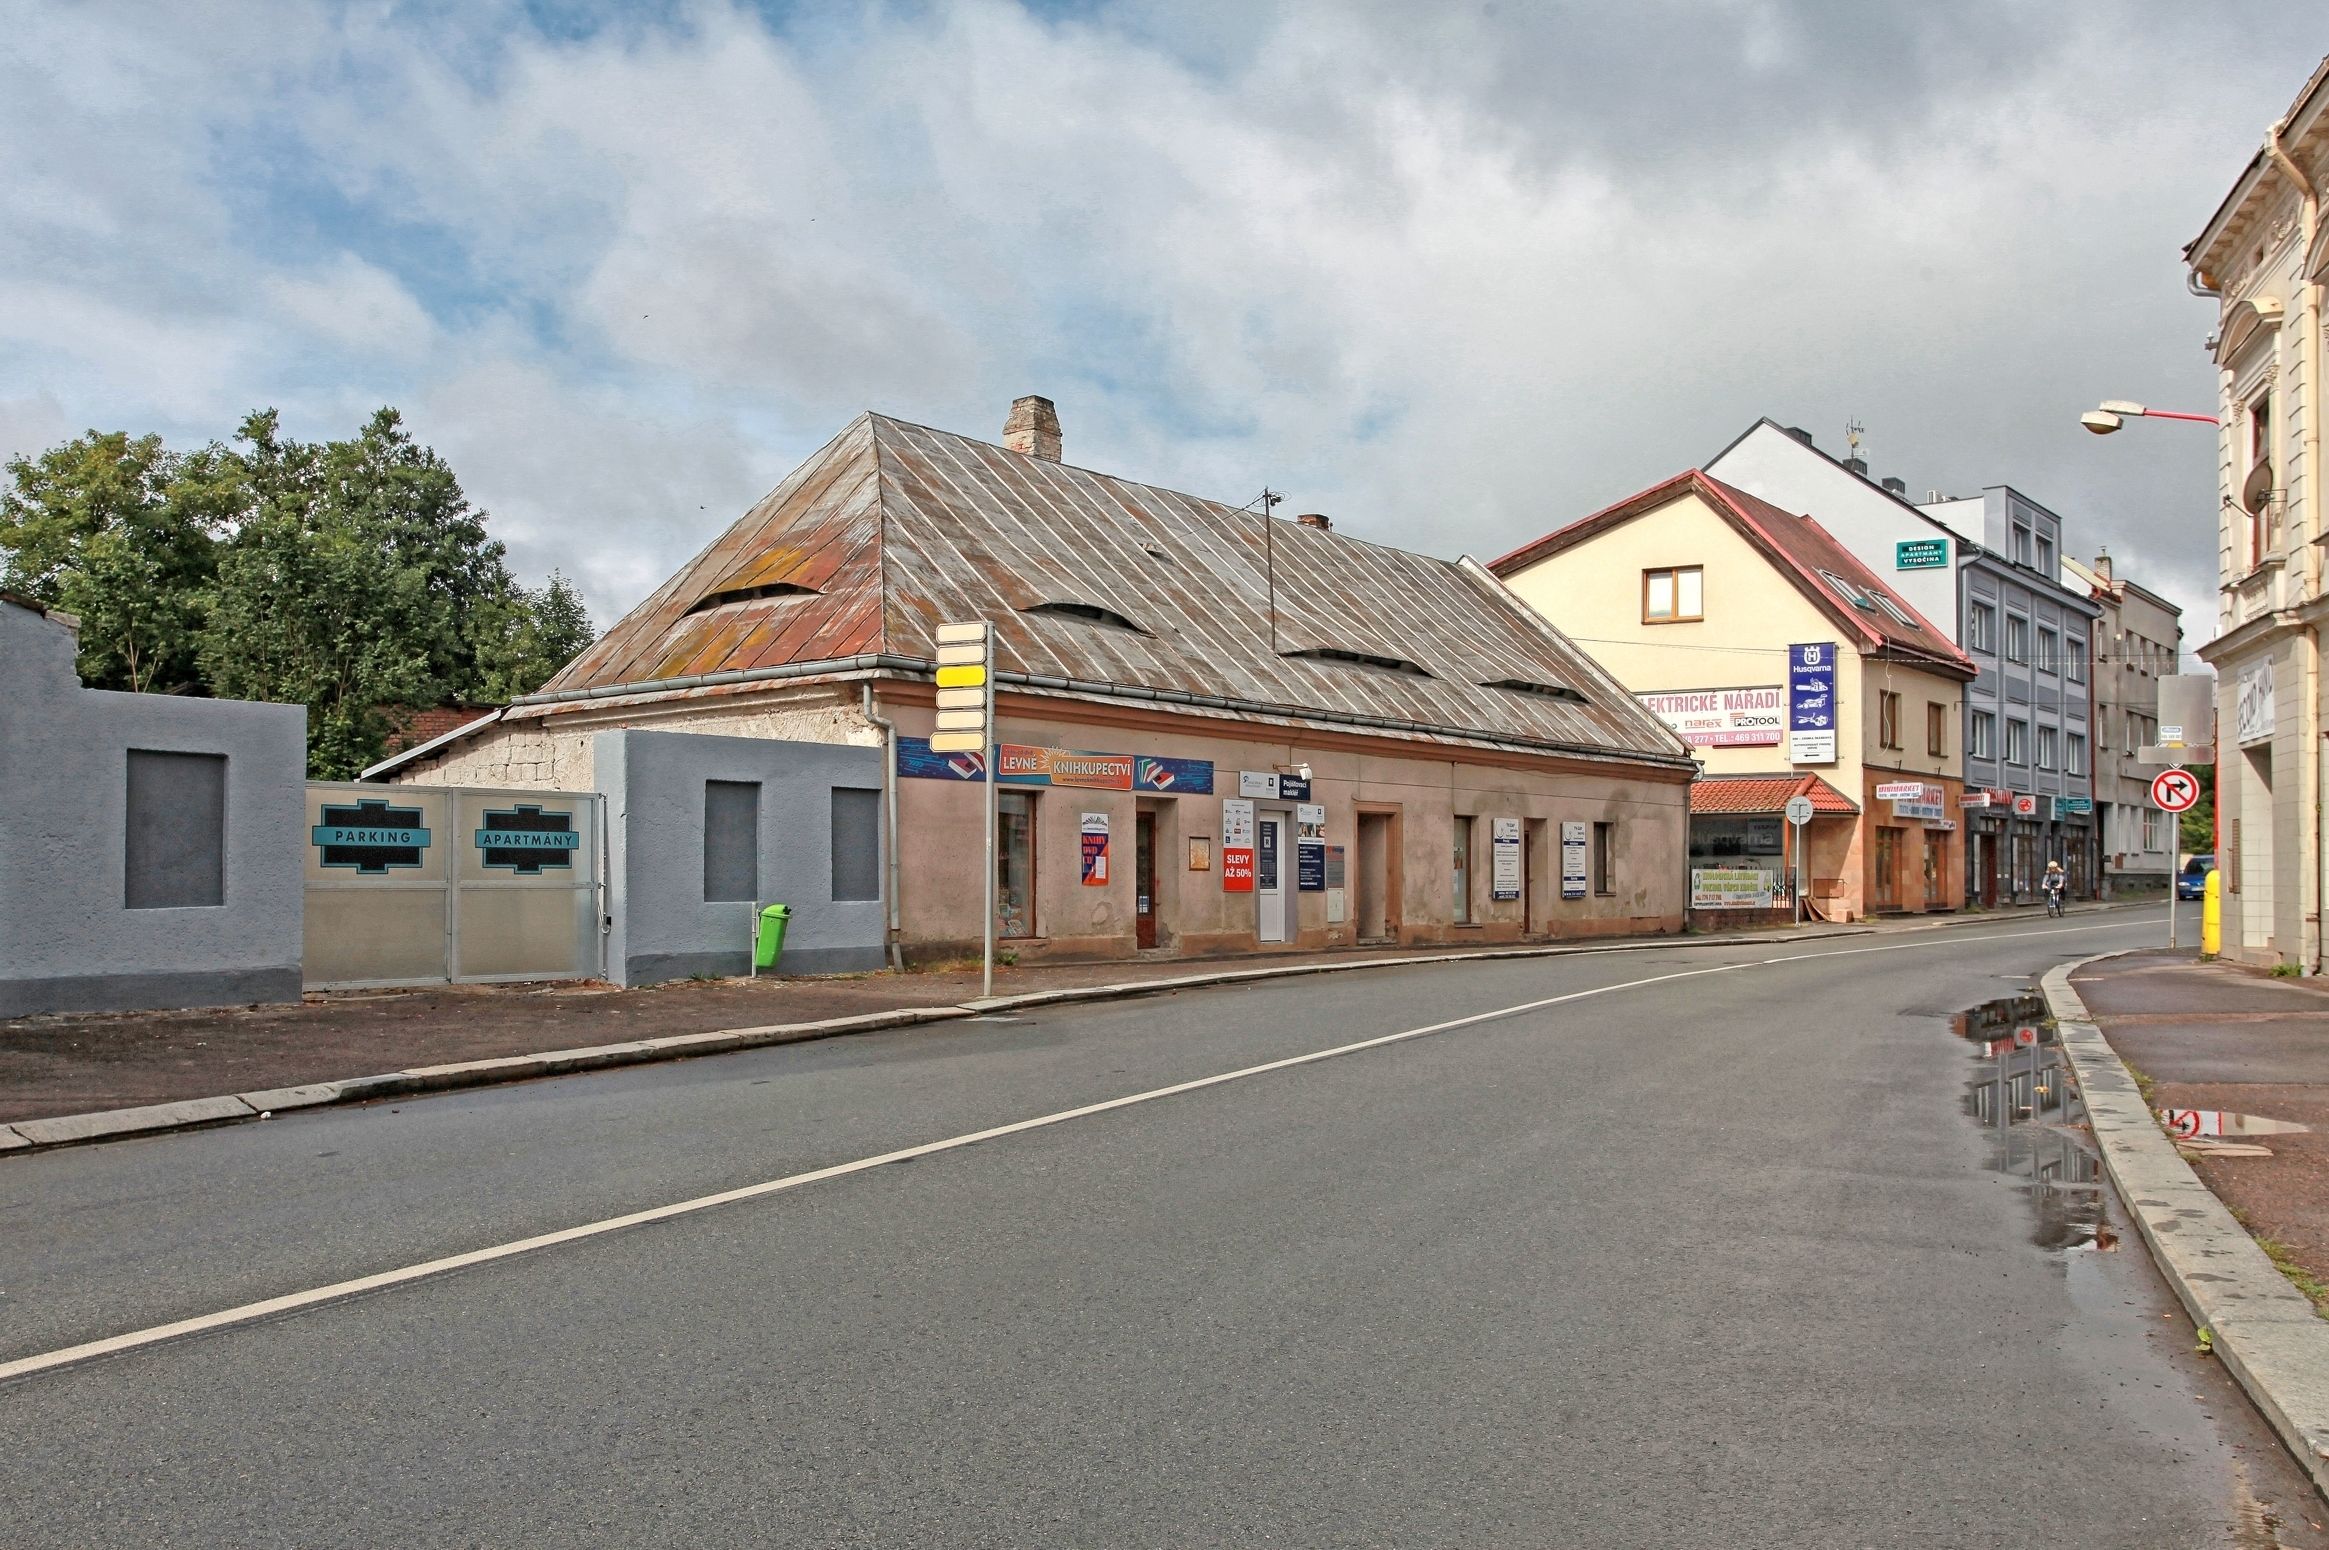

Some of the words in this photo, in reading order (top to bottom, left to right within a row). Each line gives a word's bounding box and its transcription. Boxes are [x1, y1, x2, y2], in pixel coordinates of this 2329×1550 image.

[1793, 665, 1832, 673] Husqvarna
[1642, 690, 1718, 713] EKTRICKÉ
[1723, 687, 1780, 710] NÁŘADÍ
[1684, 718, 1722, 728] narex
[1733, 717, 1780, 726] PROTOOL
[1695, 735, 1709, 743] 277
[1735, 733, 1750, 741] 469
[1003, 753, 1037, 770] LEVNÉ
[1053, 760, 1131, 776] KNIHKUPECTVÍ
[335, 830, 412, 843] PARKING
[483, 832, 573, 846] APARTMÁNY
[1083, 835, 1106, 844] KNIHY
[1083, 846, 1098, 854] DVD
[1226, 854, 1250, 864] SLEVY
[1225, 866, 1235, 877] AŽ
[1236, 868, 1252, 878] 50%
